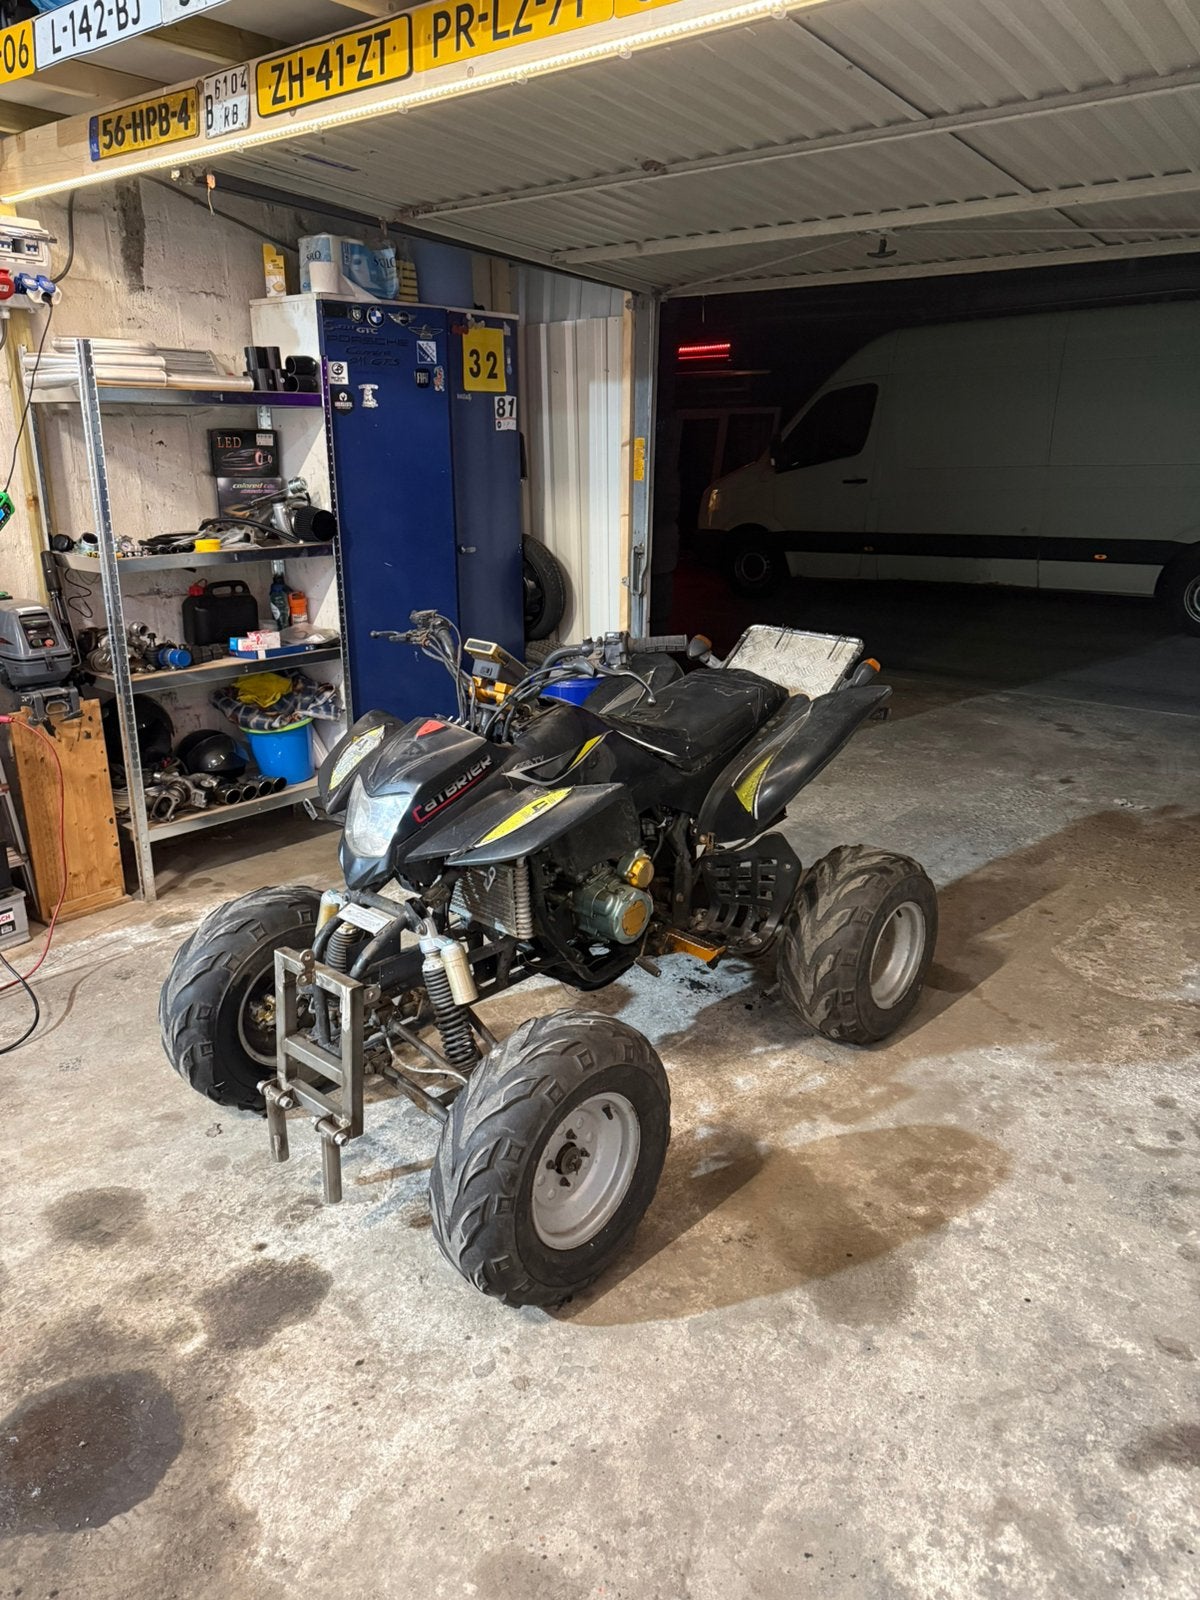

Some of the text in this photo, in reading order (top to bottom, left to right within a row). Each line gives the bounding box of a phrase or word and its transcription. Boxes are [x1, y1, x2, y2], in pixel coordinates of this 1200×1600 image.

[51, 0, 142, 55] L-142-BJ
[214, 66, 247, 100] 6104
[271, 28, 391, 106] ZH-41-ZT
[102, 97, 191, 150] 56-HPB-4
[205, 94, 239, 131] B RB
[326, 335, 409, 347] PORSCHE
[356, 327, 379, 335] GTC
[469, 348, 498, 379] 32
[496, 397, 515, 418] 81
[216, 436, 242, 448] LED
